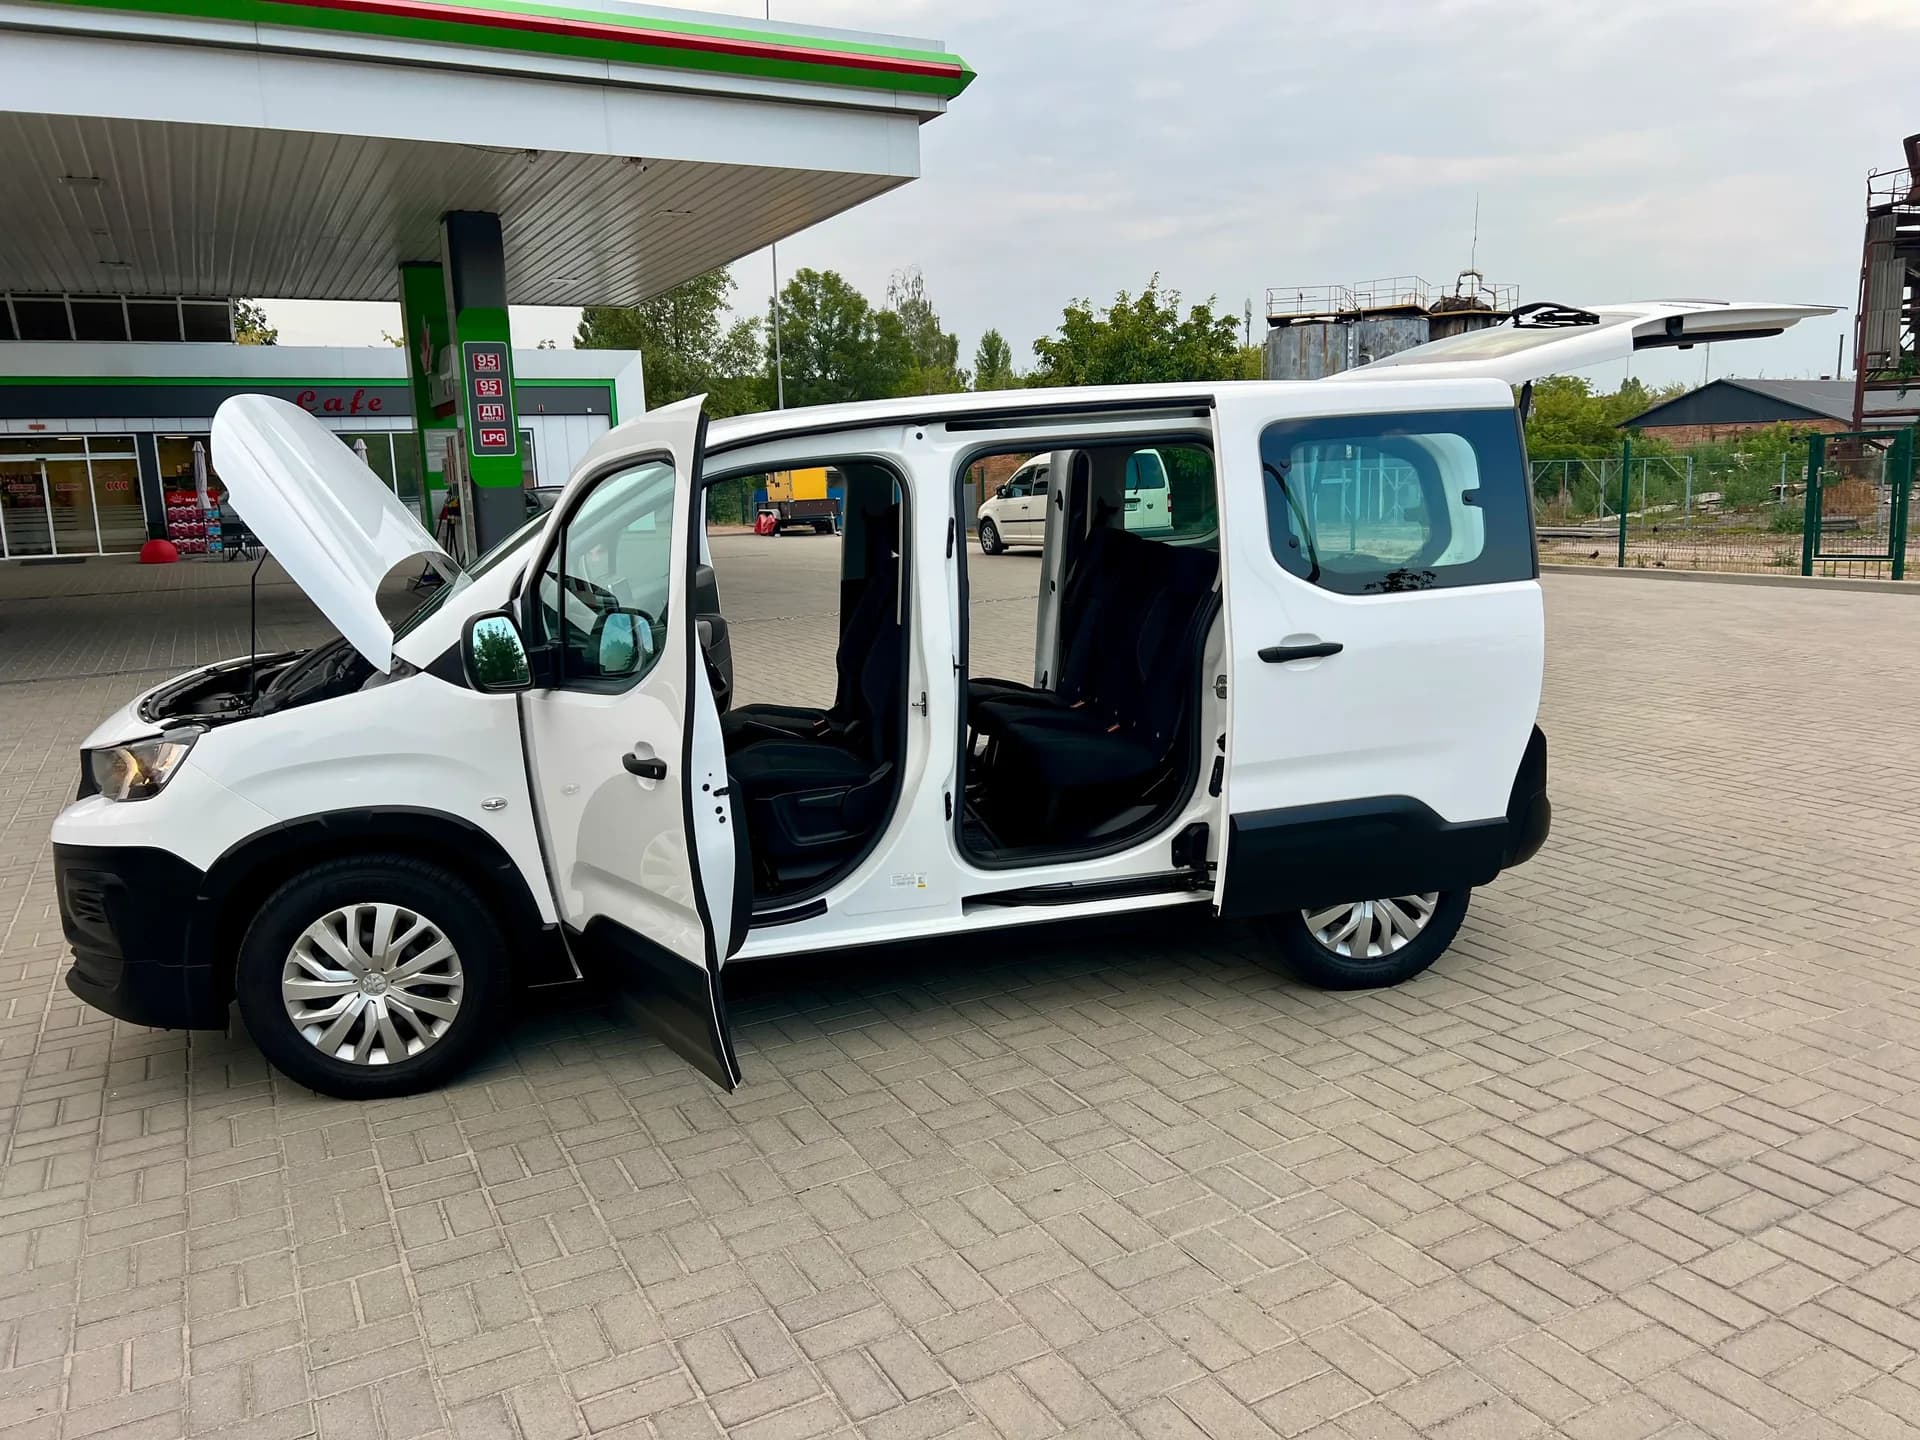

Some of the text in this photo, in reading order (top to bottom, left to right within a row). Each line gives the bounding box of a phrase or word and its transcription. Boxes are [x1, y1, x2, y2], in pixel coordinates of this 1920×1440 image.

[477, 354, 496, 367] 95
[480, 380, 498, 391] 95
[296, 388, 383, 415] Cafe
[481, 405, 502, 417] ДП
[483, 433, 505, 442] LPG
